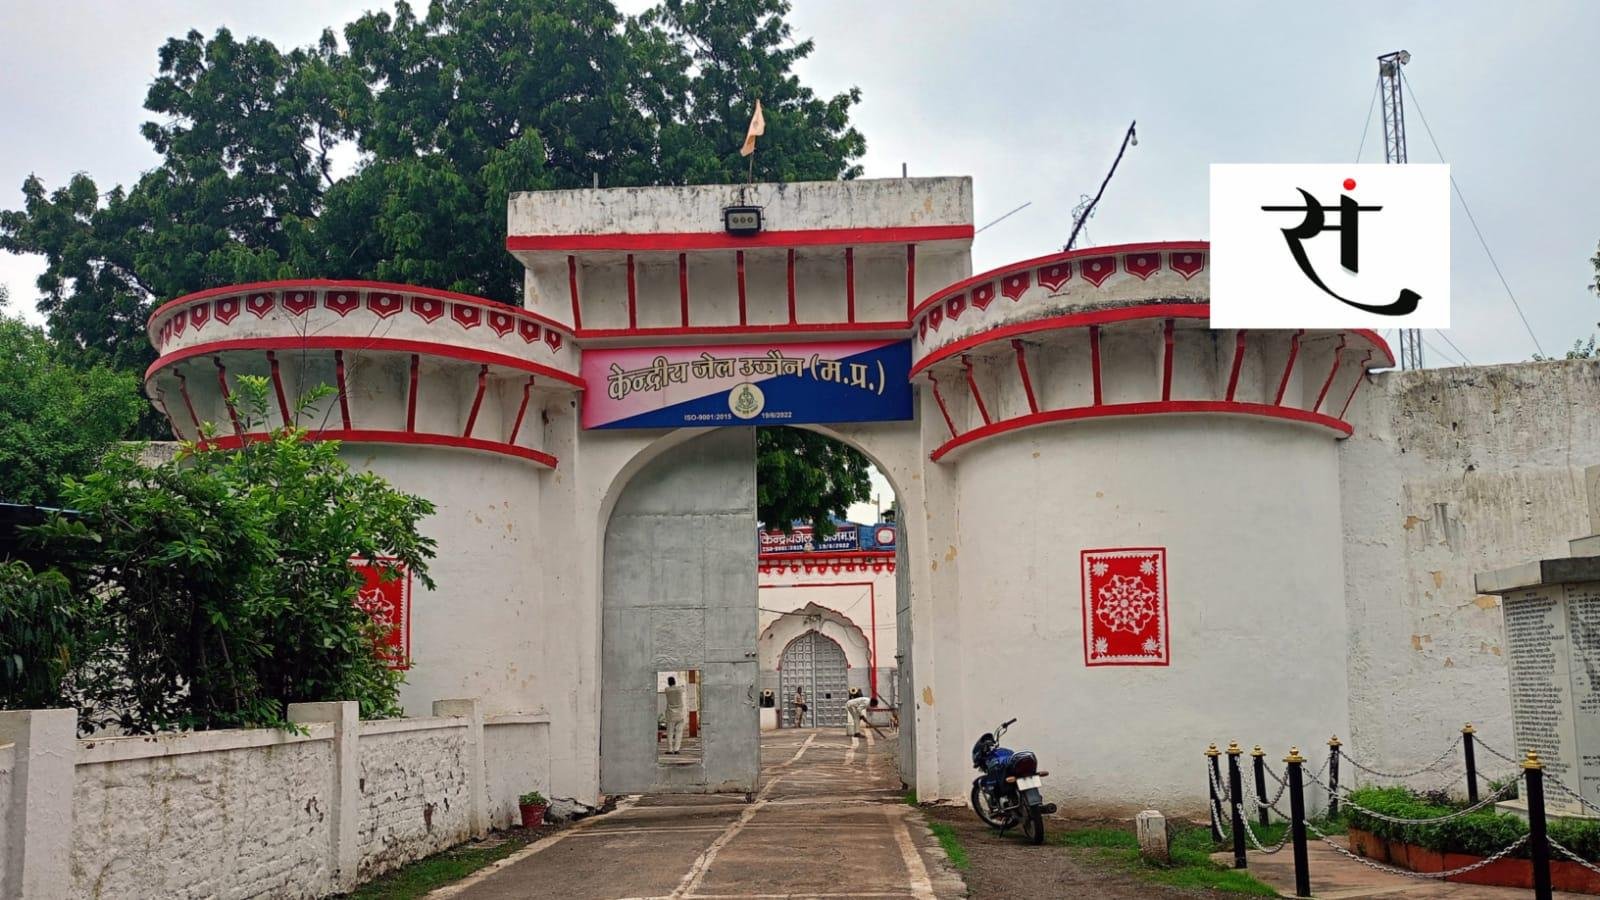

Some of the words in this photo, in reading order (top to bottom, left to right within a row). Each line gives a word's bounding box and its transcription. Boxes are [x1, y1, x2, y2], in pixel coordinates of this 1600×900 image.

[607, 355, 689, 400] केन्द्रीय
[691, 351, 736, 378] जेल
[739, 349, 805, 377] उज्जैन
[810, 353, 886, 396] (म.प्र.)
